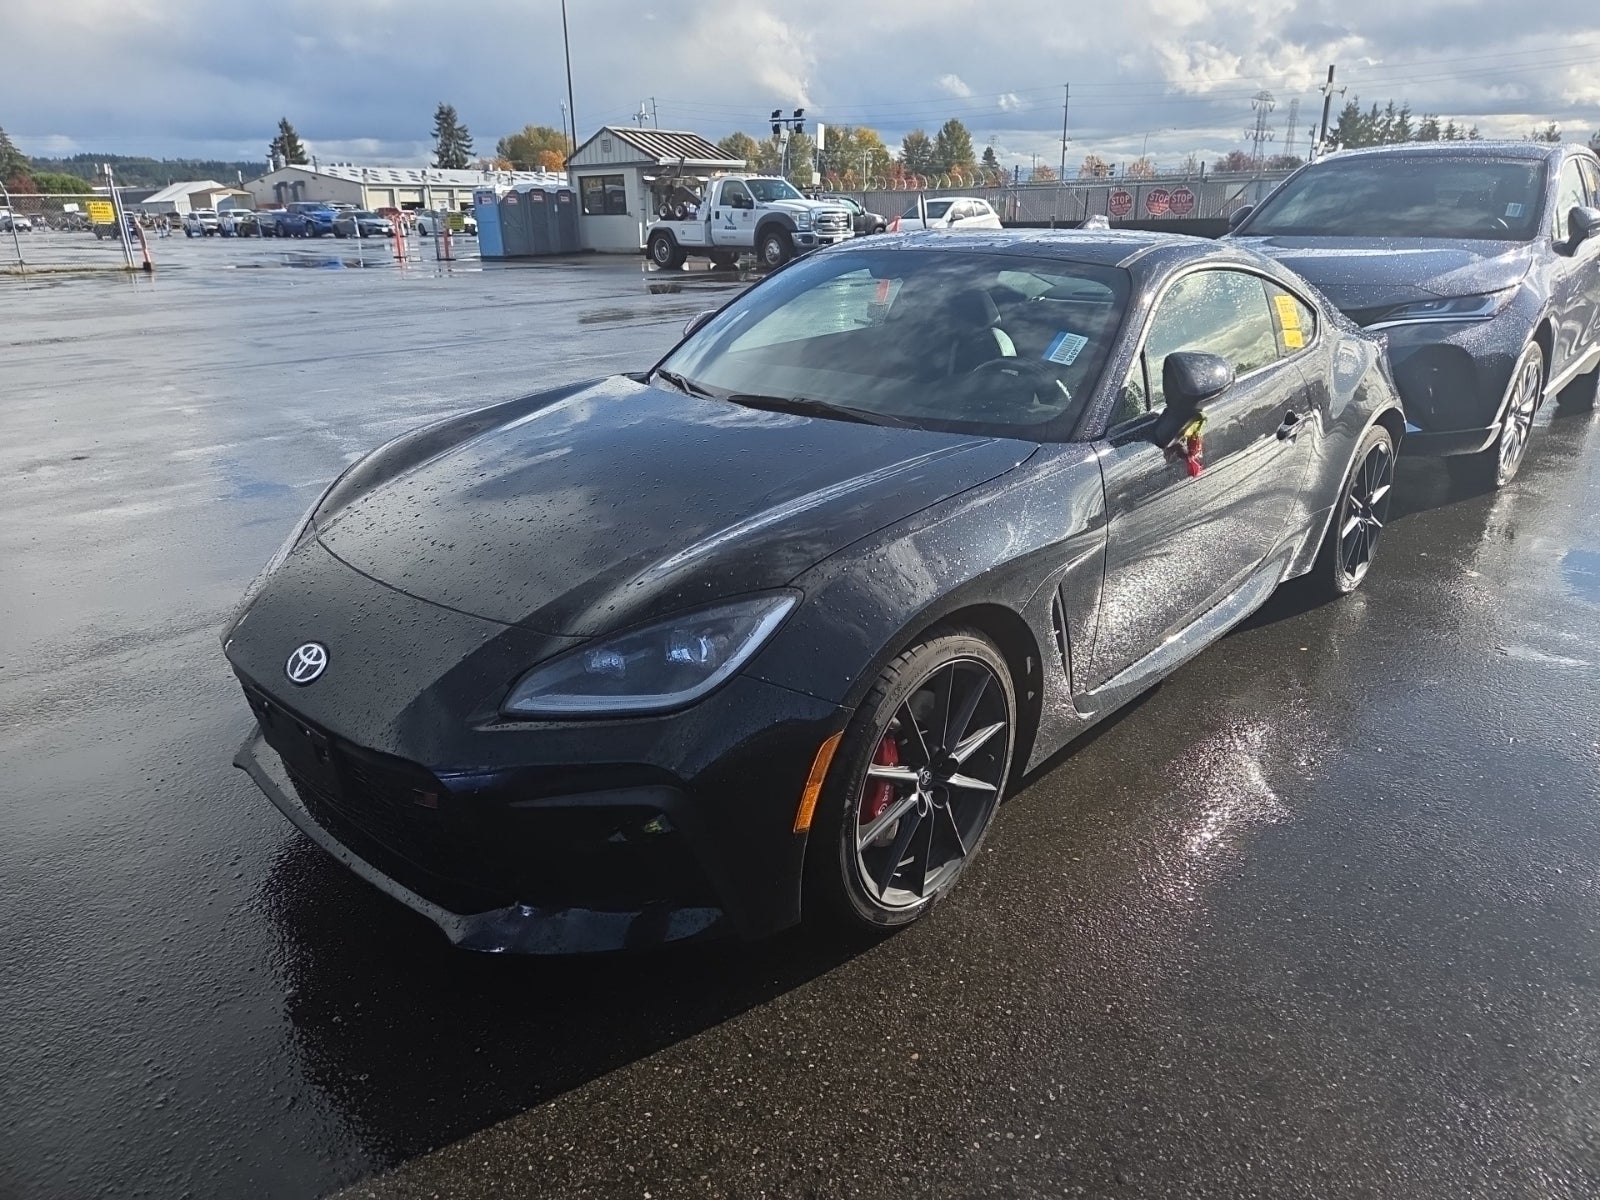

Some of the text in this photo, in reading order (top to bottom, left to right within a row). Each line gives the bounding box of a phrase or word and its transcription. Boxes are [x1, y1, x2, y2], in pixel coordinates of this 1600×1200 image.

[1111, 195, 1130, 204] STOP
[1149, 193, 1169, 203] STOP
[1172, 194, 1192, 203] STOP
